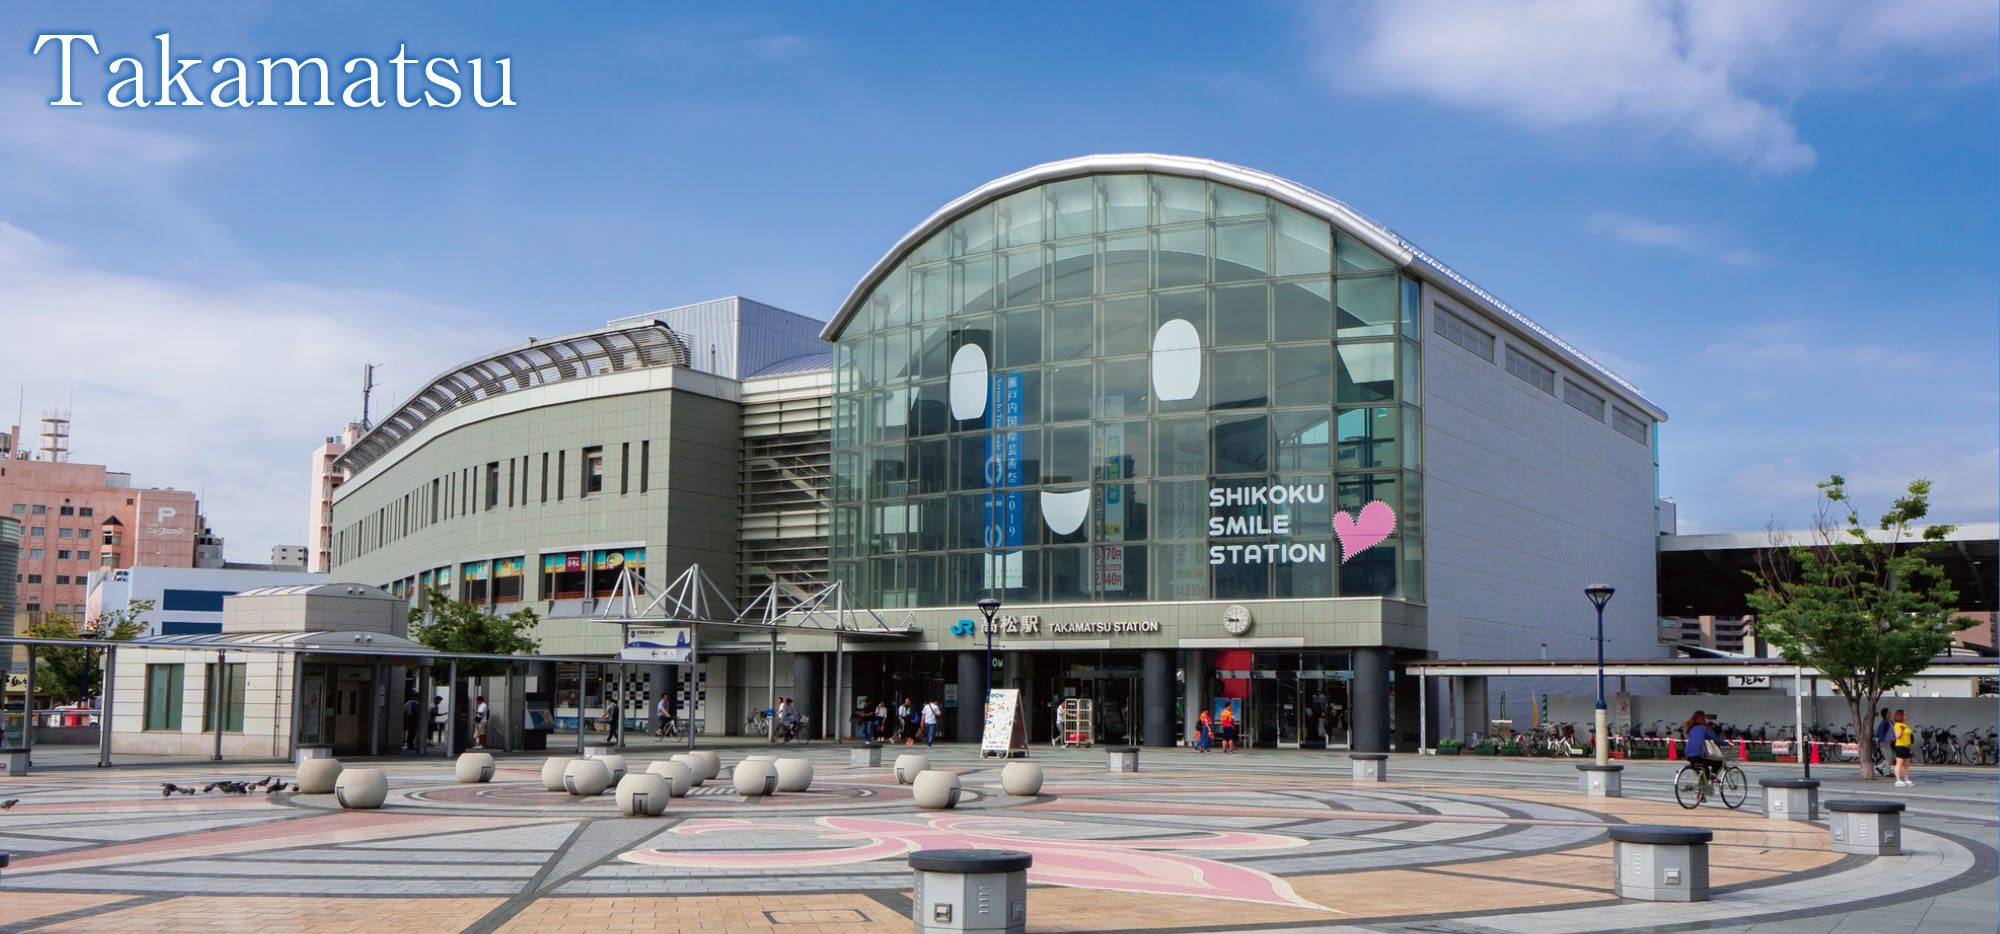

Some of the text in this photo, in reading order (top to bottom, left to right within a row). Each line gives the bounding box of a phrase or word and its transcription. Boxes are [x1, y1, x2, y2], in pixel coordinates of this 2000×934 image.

[1209, 484, 1324, 507] SHIKOKU
[158, 507, 176, 522] P
[1208, 514, 1289, 536] SMILE
[1209, 543, 1326, 565] STATION
[950, 619, 975, 635] JR
[981, 615, 1039, 634] 高松駅
[1049, 621, 1159, 633] TAKAMATSU STATION
